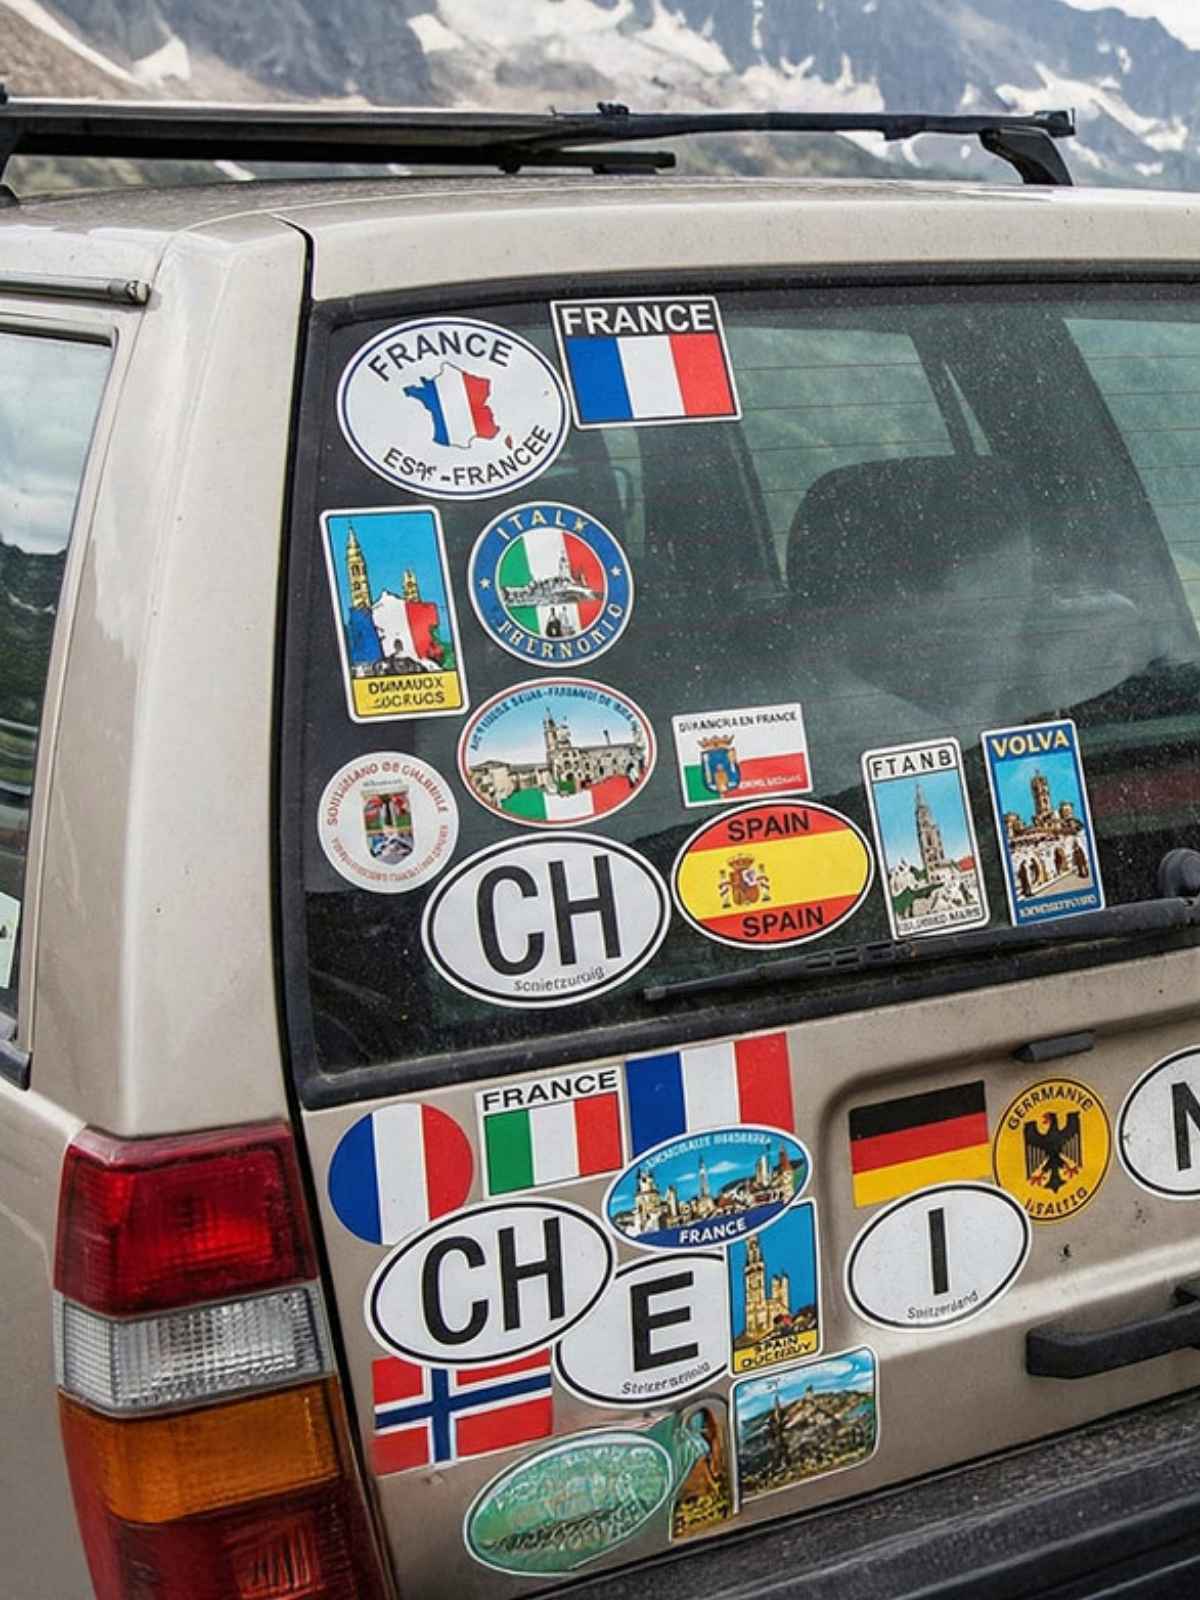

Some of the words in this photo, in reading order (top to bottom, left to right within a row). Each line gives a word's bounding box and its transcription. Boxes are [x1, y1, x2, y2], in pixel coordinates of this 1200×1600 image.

[561, 302, 715, 337] FRANCE
[368, 331, 513, 383] FRANCE
[991, 728, 1071, 758] VOLVA
[871, 749, 952, 777] FTANB
[727, 810, 810, 842] SPAIN
[475, 853, 622, 976] CH
[742, 907, 825, 938] SPAIN
[482, 1069, 617, 1112] FRANCE
[680, 1217, 747, 1244] FRANCE
[927, 1206, 950, 1296] I
[421, 1216, 566, 1347] CH
[630, 1270, 699, 1372] E
